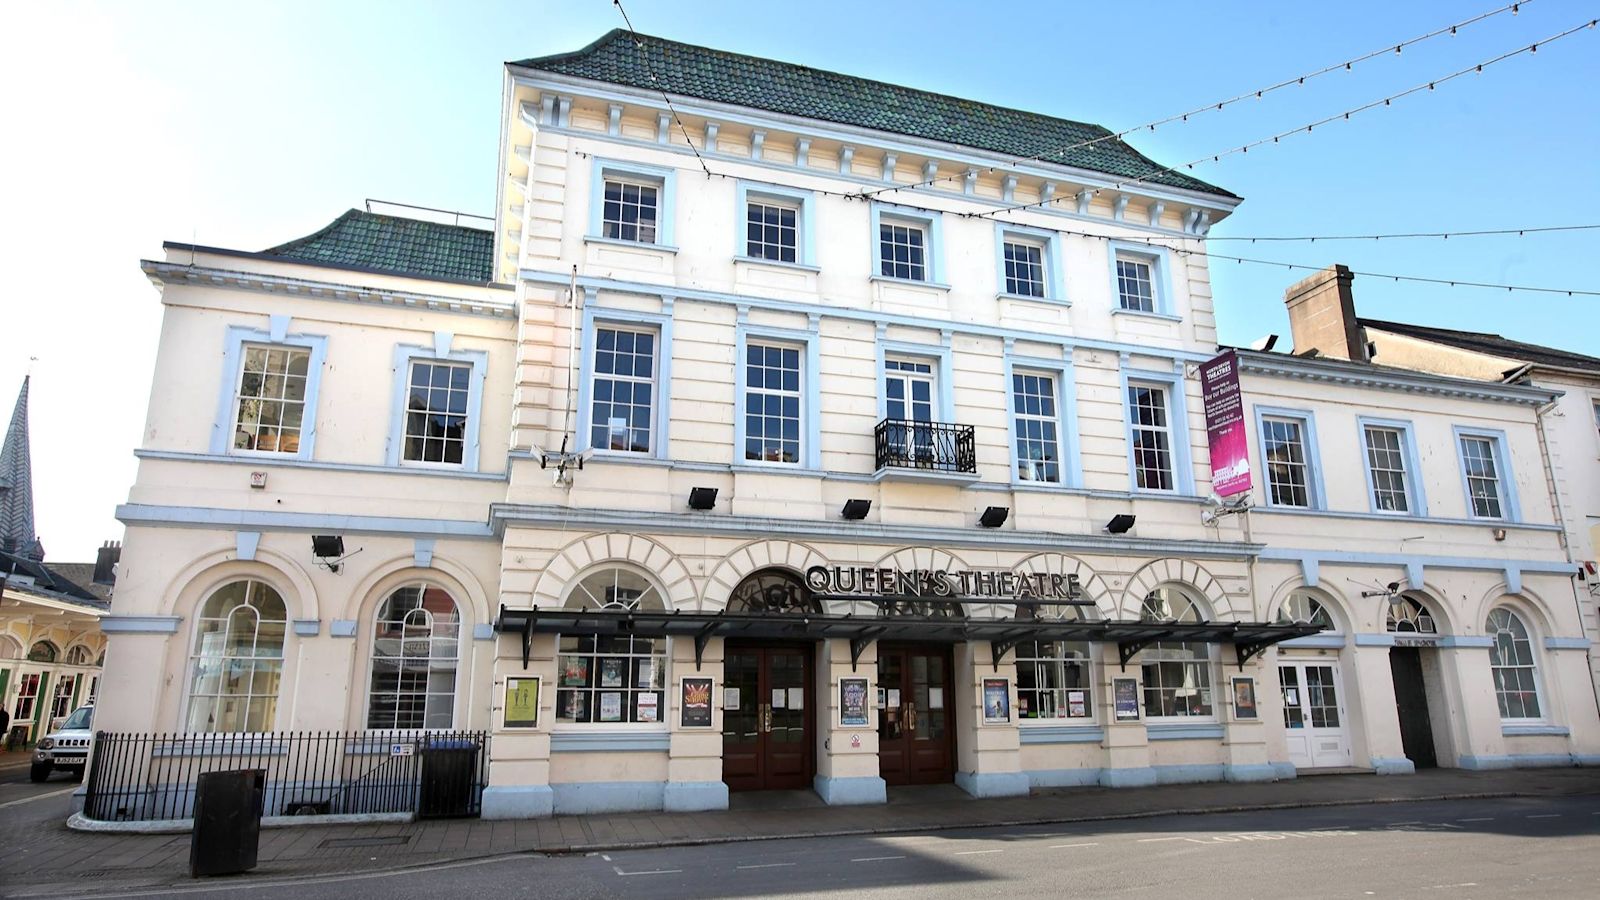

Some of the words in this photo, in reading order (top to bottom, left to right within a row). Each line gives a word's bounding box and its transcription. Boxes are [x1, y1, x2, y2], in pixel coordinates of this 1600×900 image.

[1206, 364, 1231, 380] THEATRES
[804, 565, 951, 597] QUEEN'S
[957, 569, 1081, 598] THEATRE
